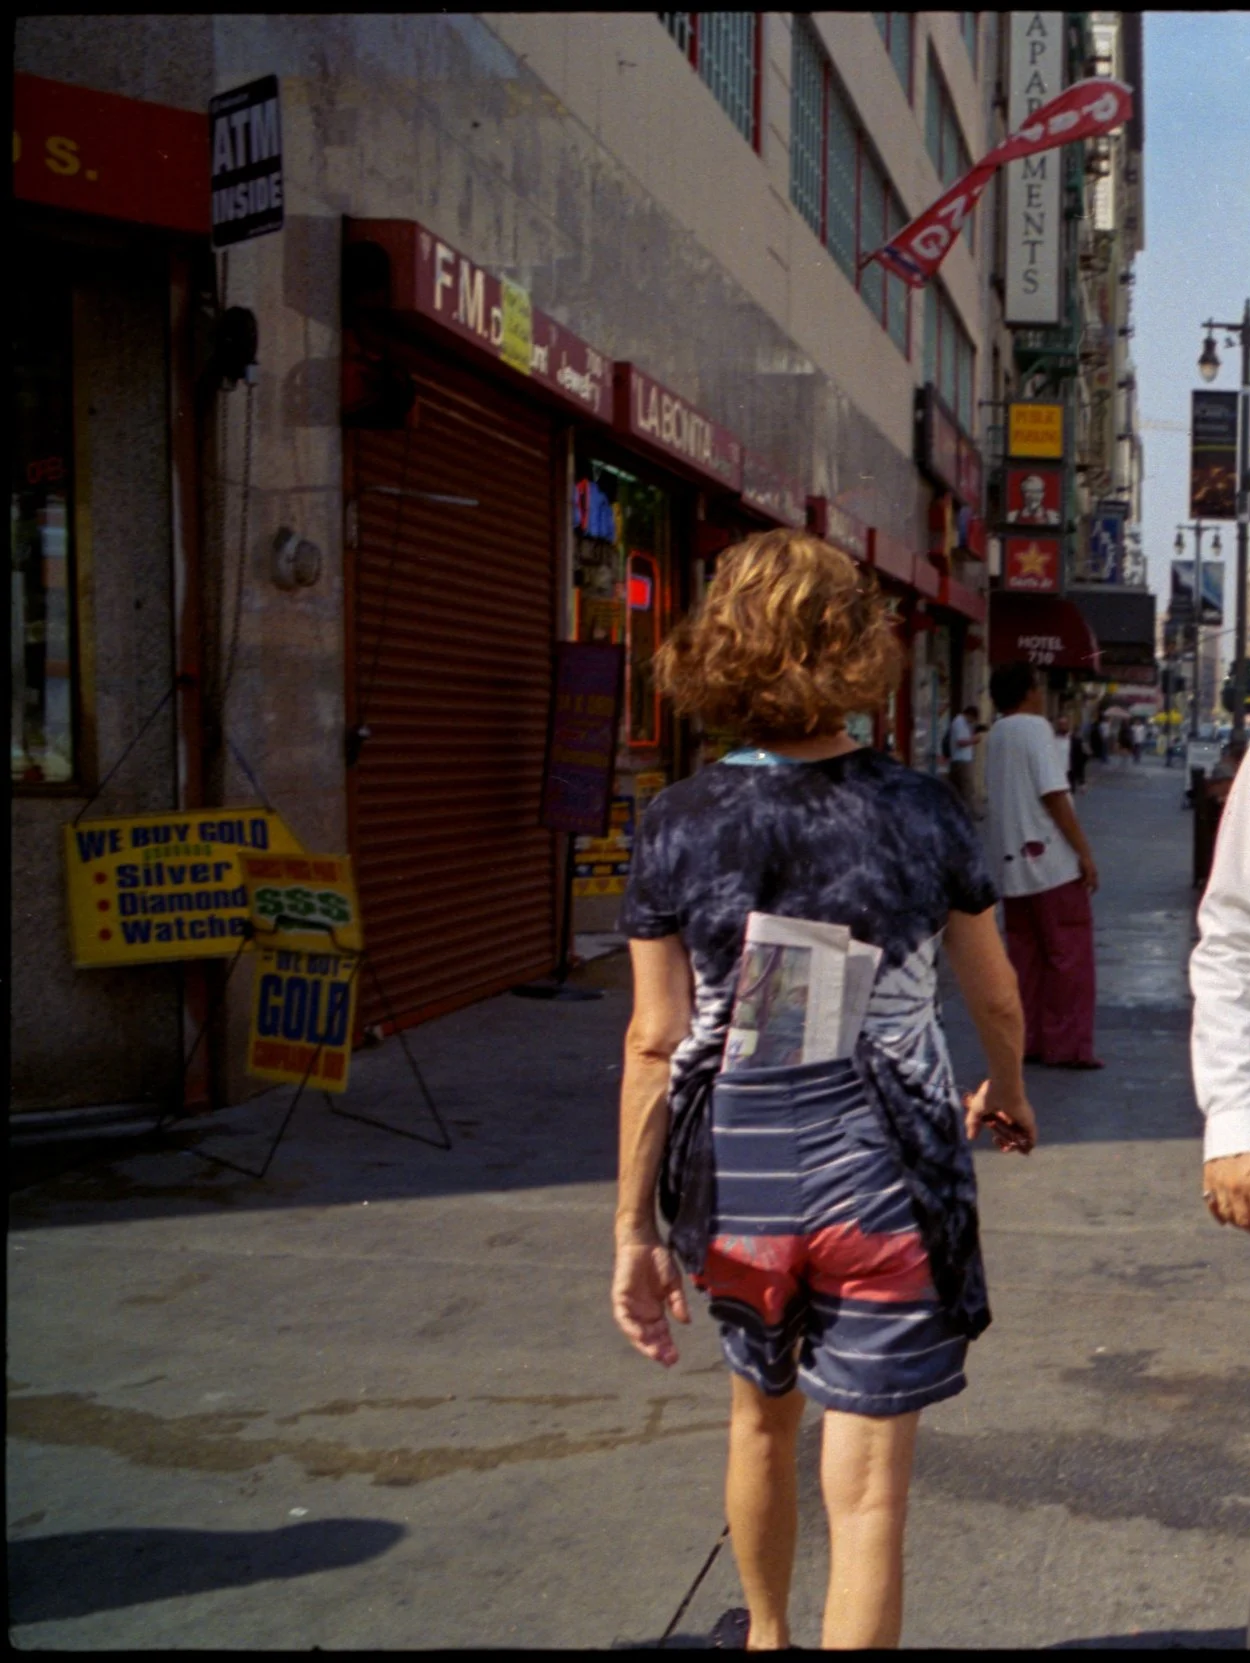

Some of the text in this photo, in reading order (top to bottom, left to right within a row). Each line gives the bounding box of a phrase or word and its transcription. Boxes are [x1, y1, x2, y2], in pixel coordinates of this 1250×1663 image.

[213, 96, 279, 176] ATM
[1021, 12, 1048, 295] APAMENTS
[212, 178, 283, 224] INSIDE
[1017, 634, 1066, 651] HOTEL
[76, 828, 121, 863] WE
[131, 823, 191, 848] BUY
[198, 818, 270, 850] GOLD
[116, 860, 234, 888] Silver
[118, 884, 249, 917] Diamond
[121, 914, 248, 945] Watche
[257, 973, 350, 1046] GOLD
